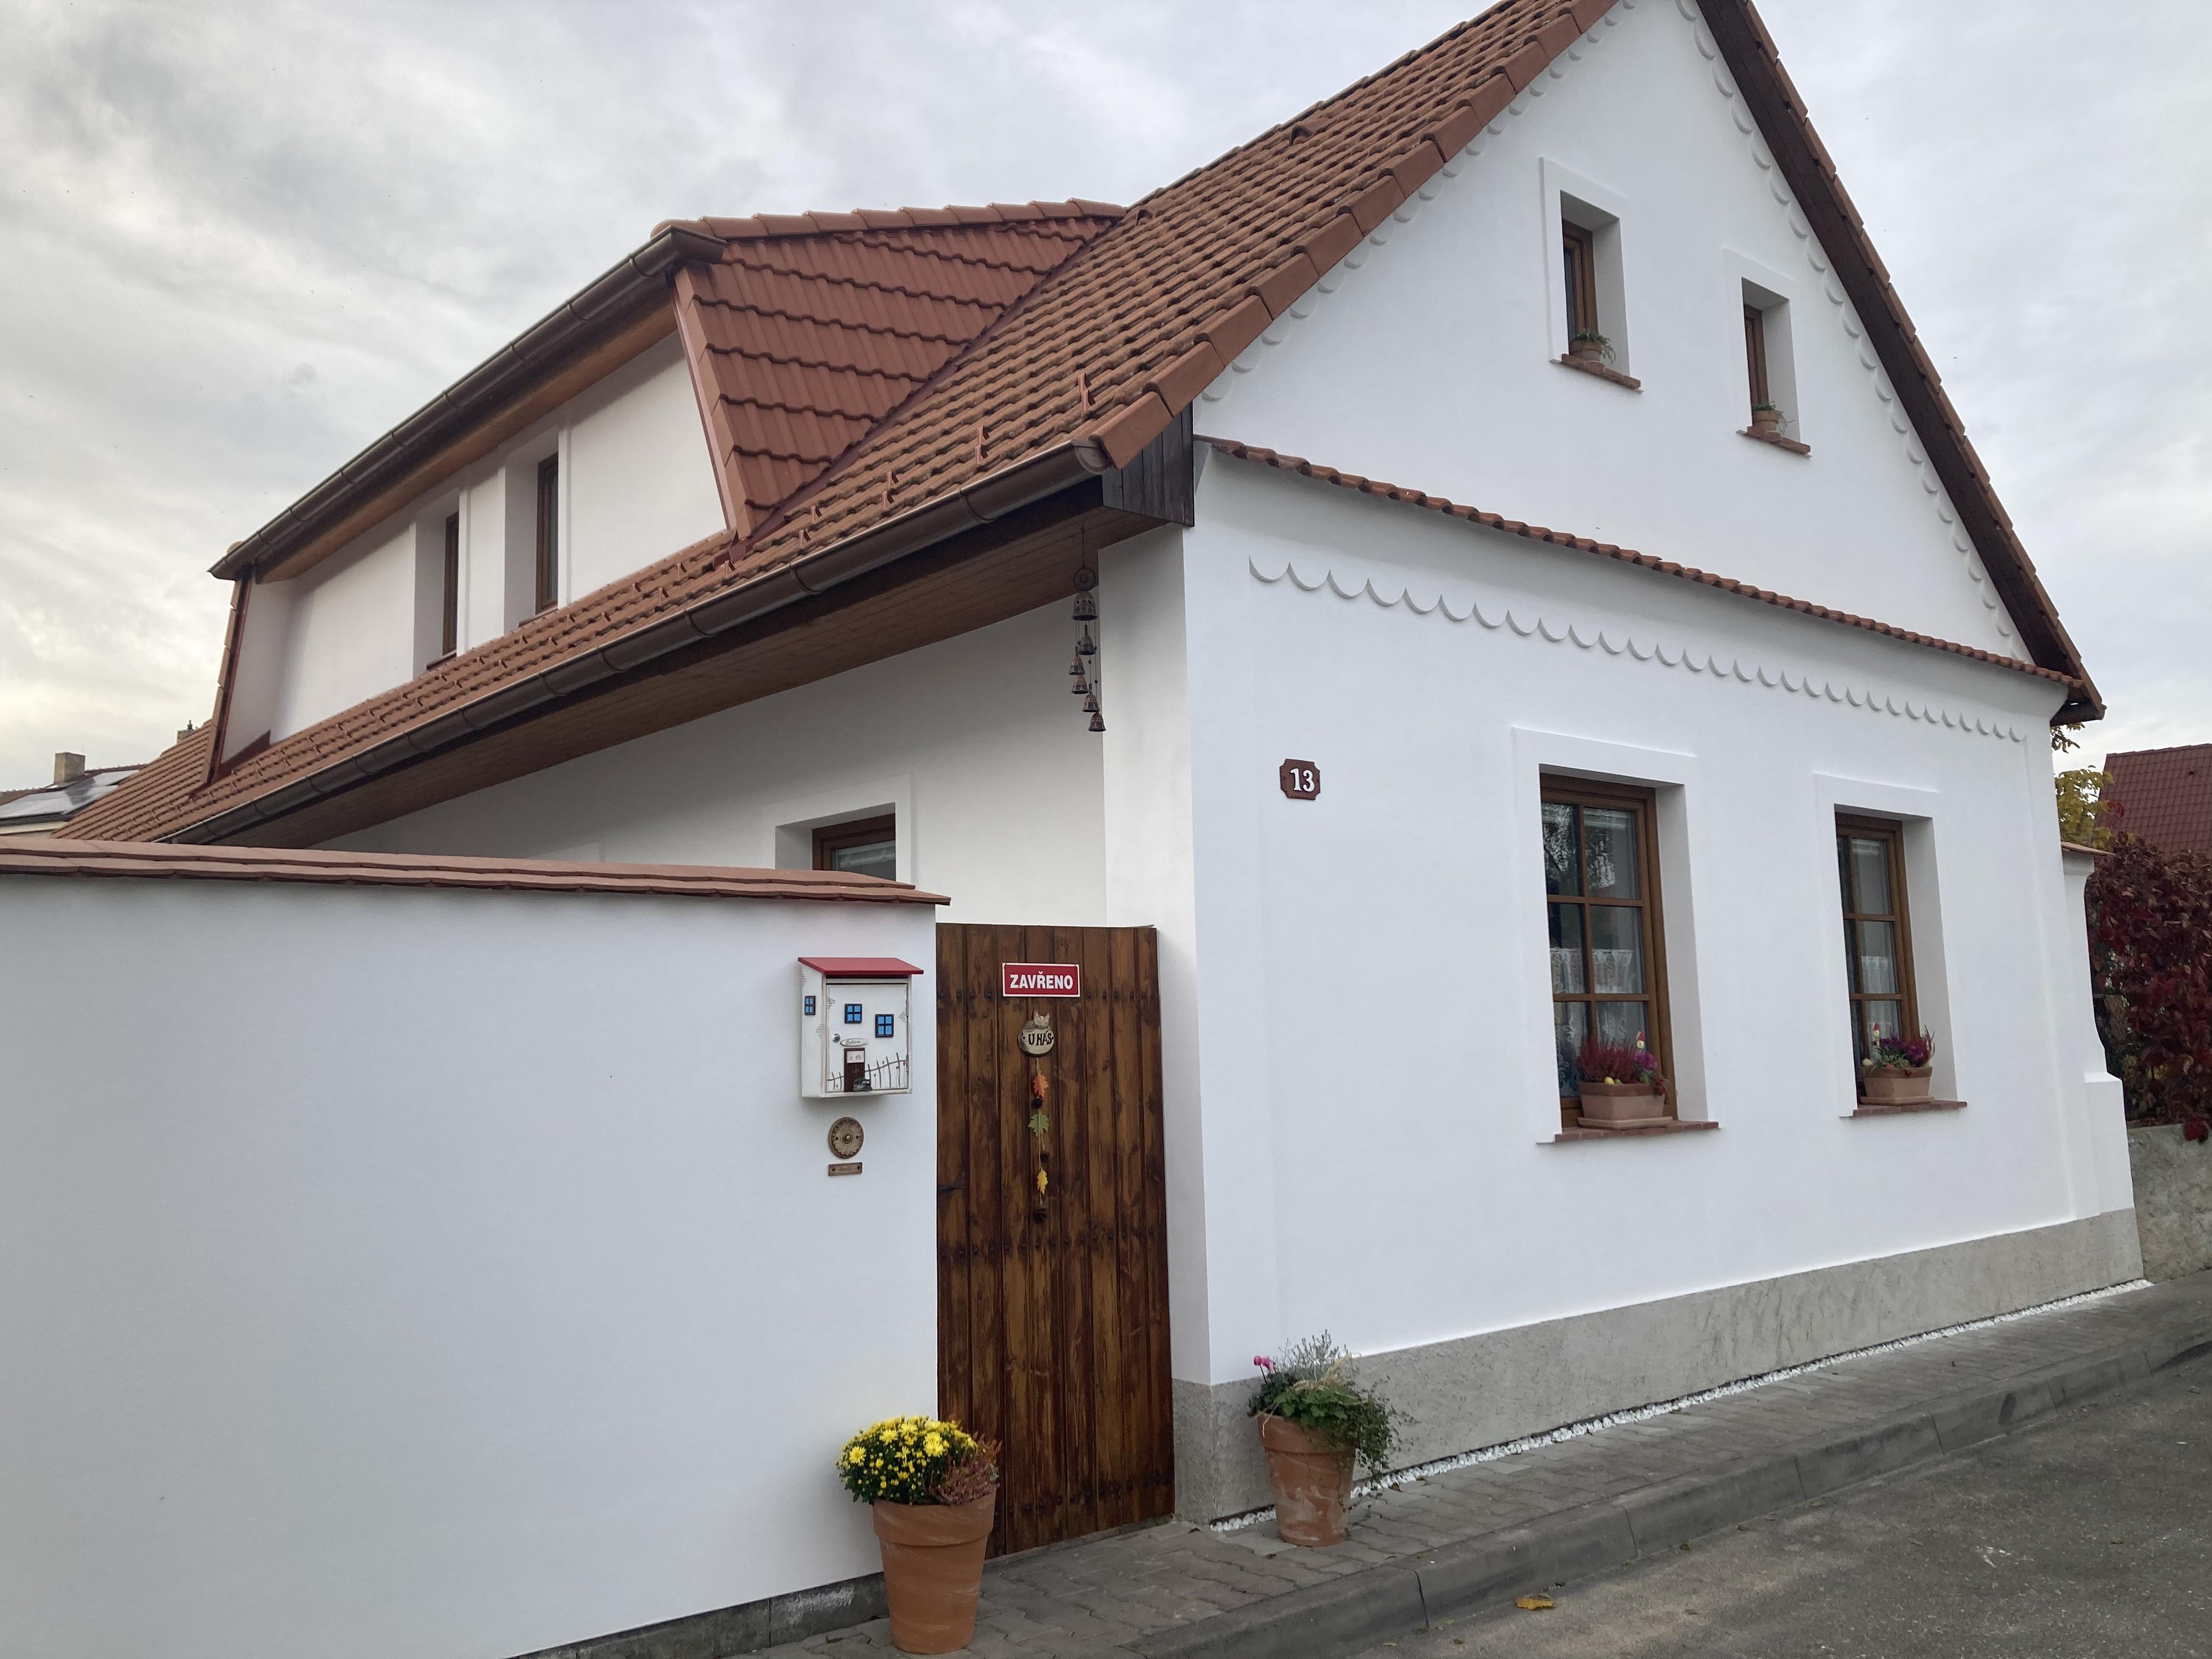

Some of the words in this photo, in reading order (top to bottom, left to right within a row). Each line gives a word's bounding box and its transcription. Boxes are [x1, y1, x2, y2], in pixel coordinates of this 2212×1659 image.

[1290, 768, 1315, 792] 13
[1010, 971, 1073, 989] ZAVŘENO
[1028, 1034, 1035, 1045] U
